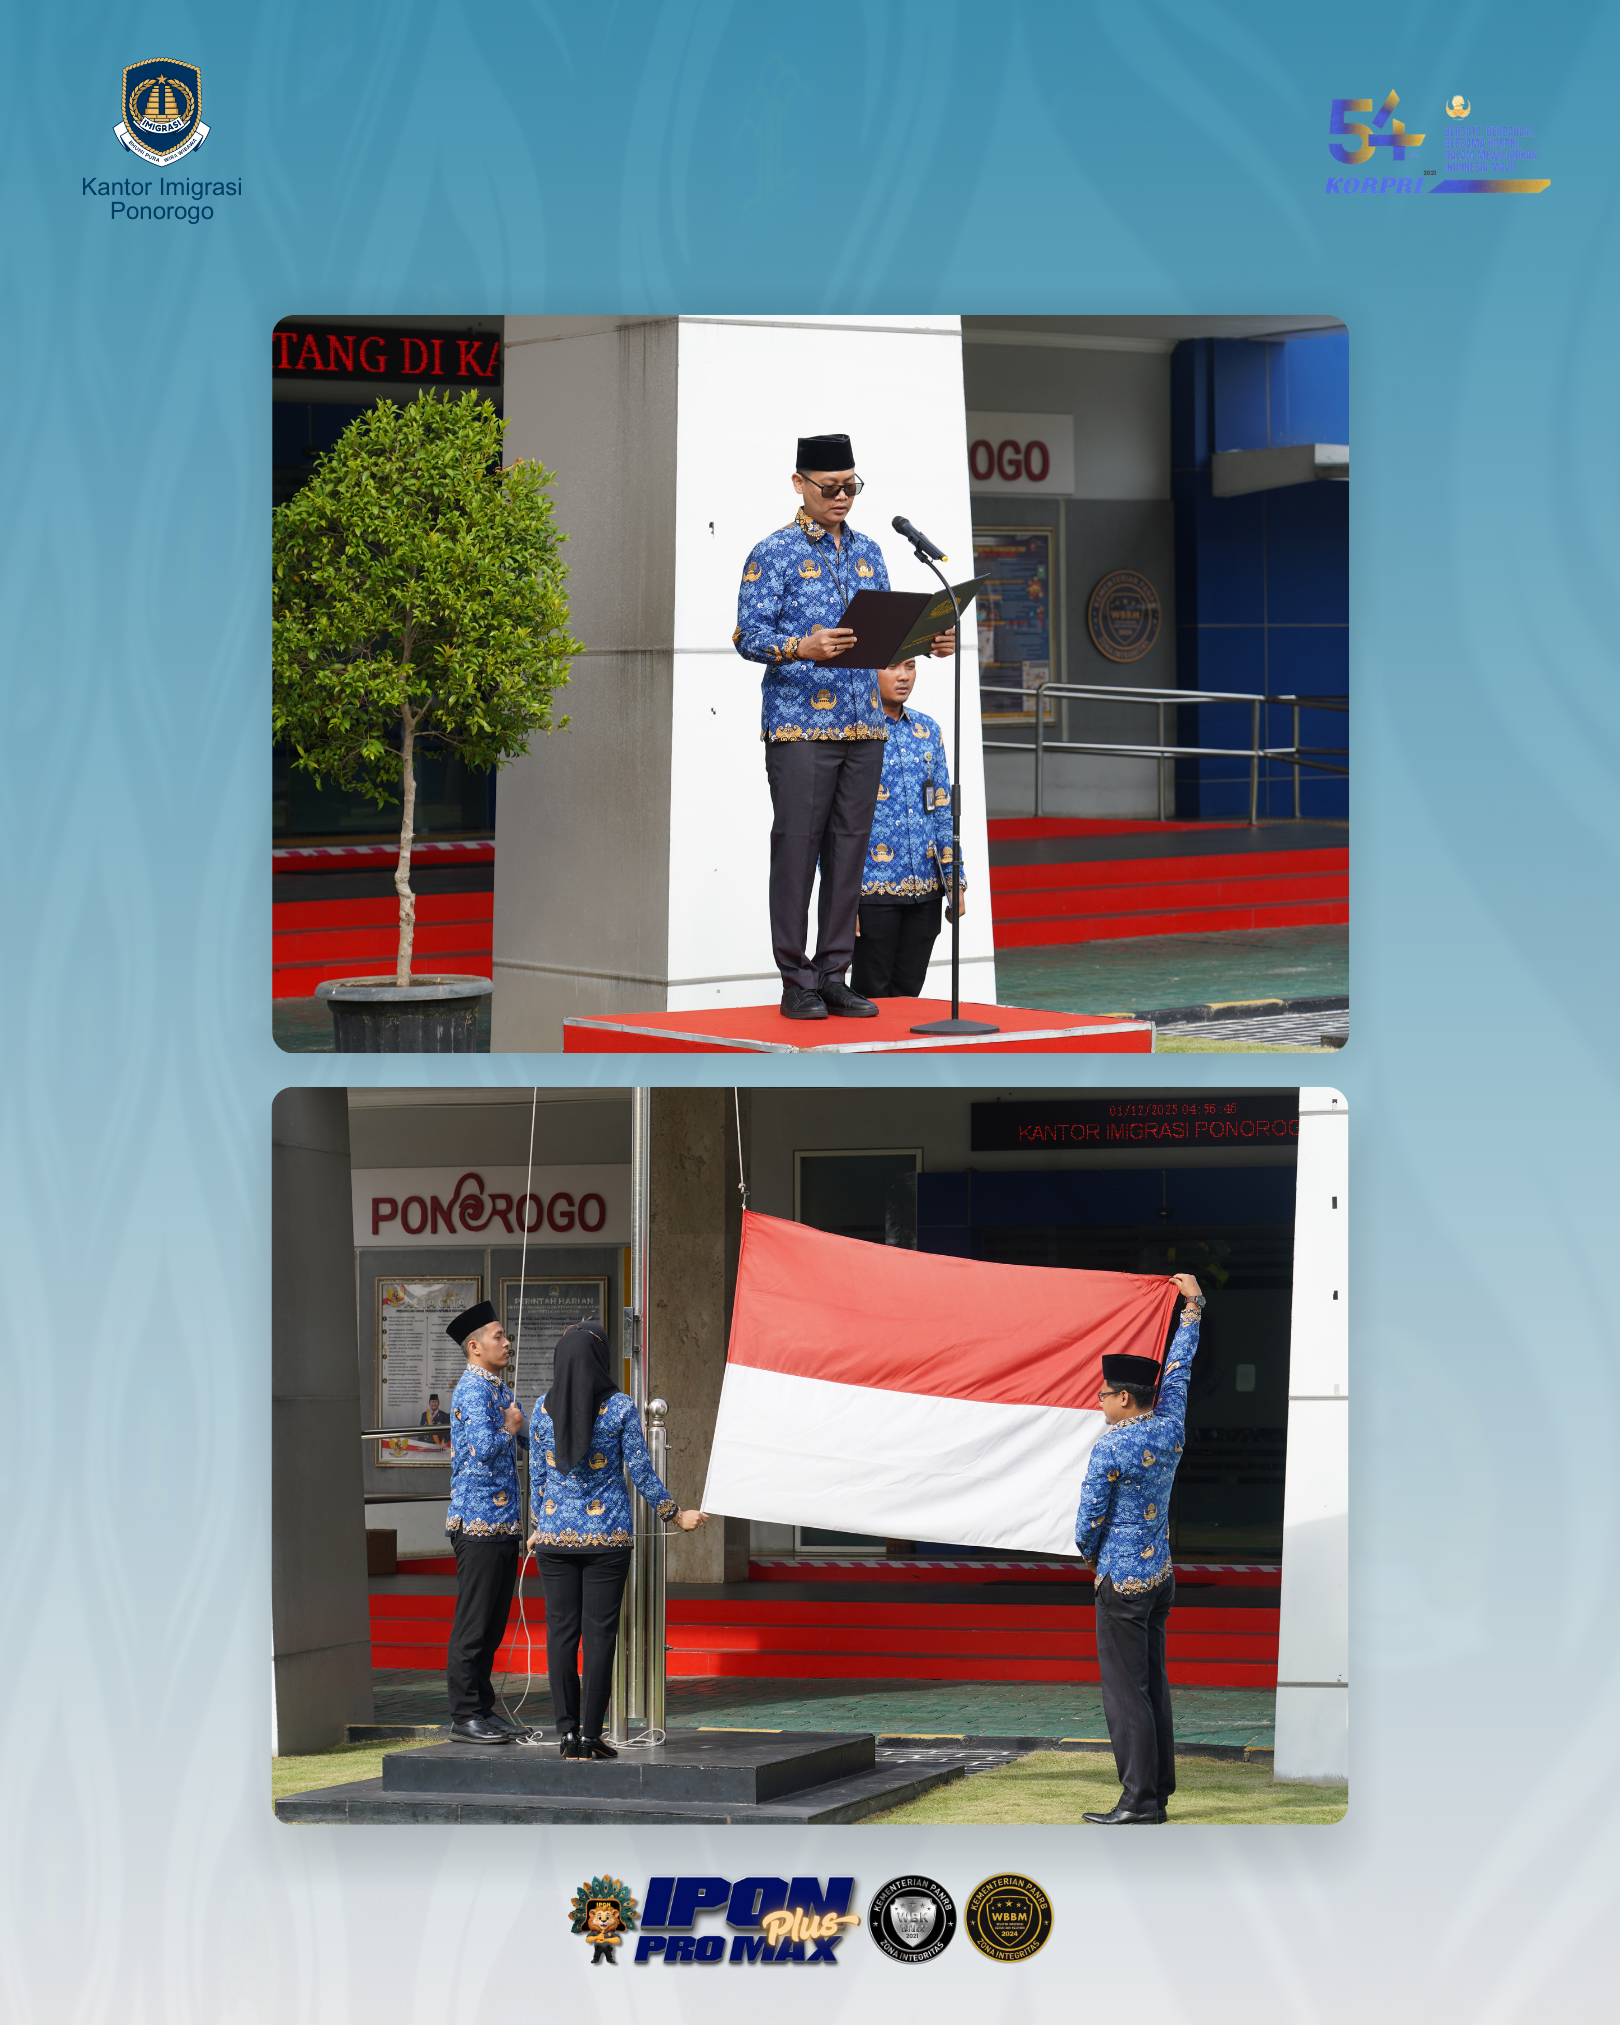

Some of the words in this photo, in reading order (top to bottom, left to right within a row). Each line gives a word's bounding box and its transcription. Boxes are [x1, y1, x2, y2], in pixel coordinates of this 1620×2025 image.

[272, 332, 388, 373] TANG
[400, 338, 444, 375] DI
[1019, 1122, 1100, 1142] KANTOR
[1106, 1122, 1189, 1140] IMIGRASI
[372, 1172, 606, 1235] PONOROGO
